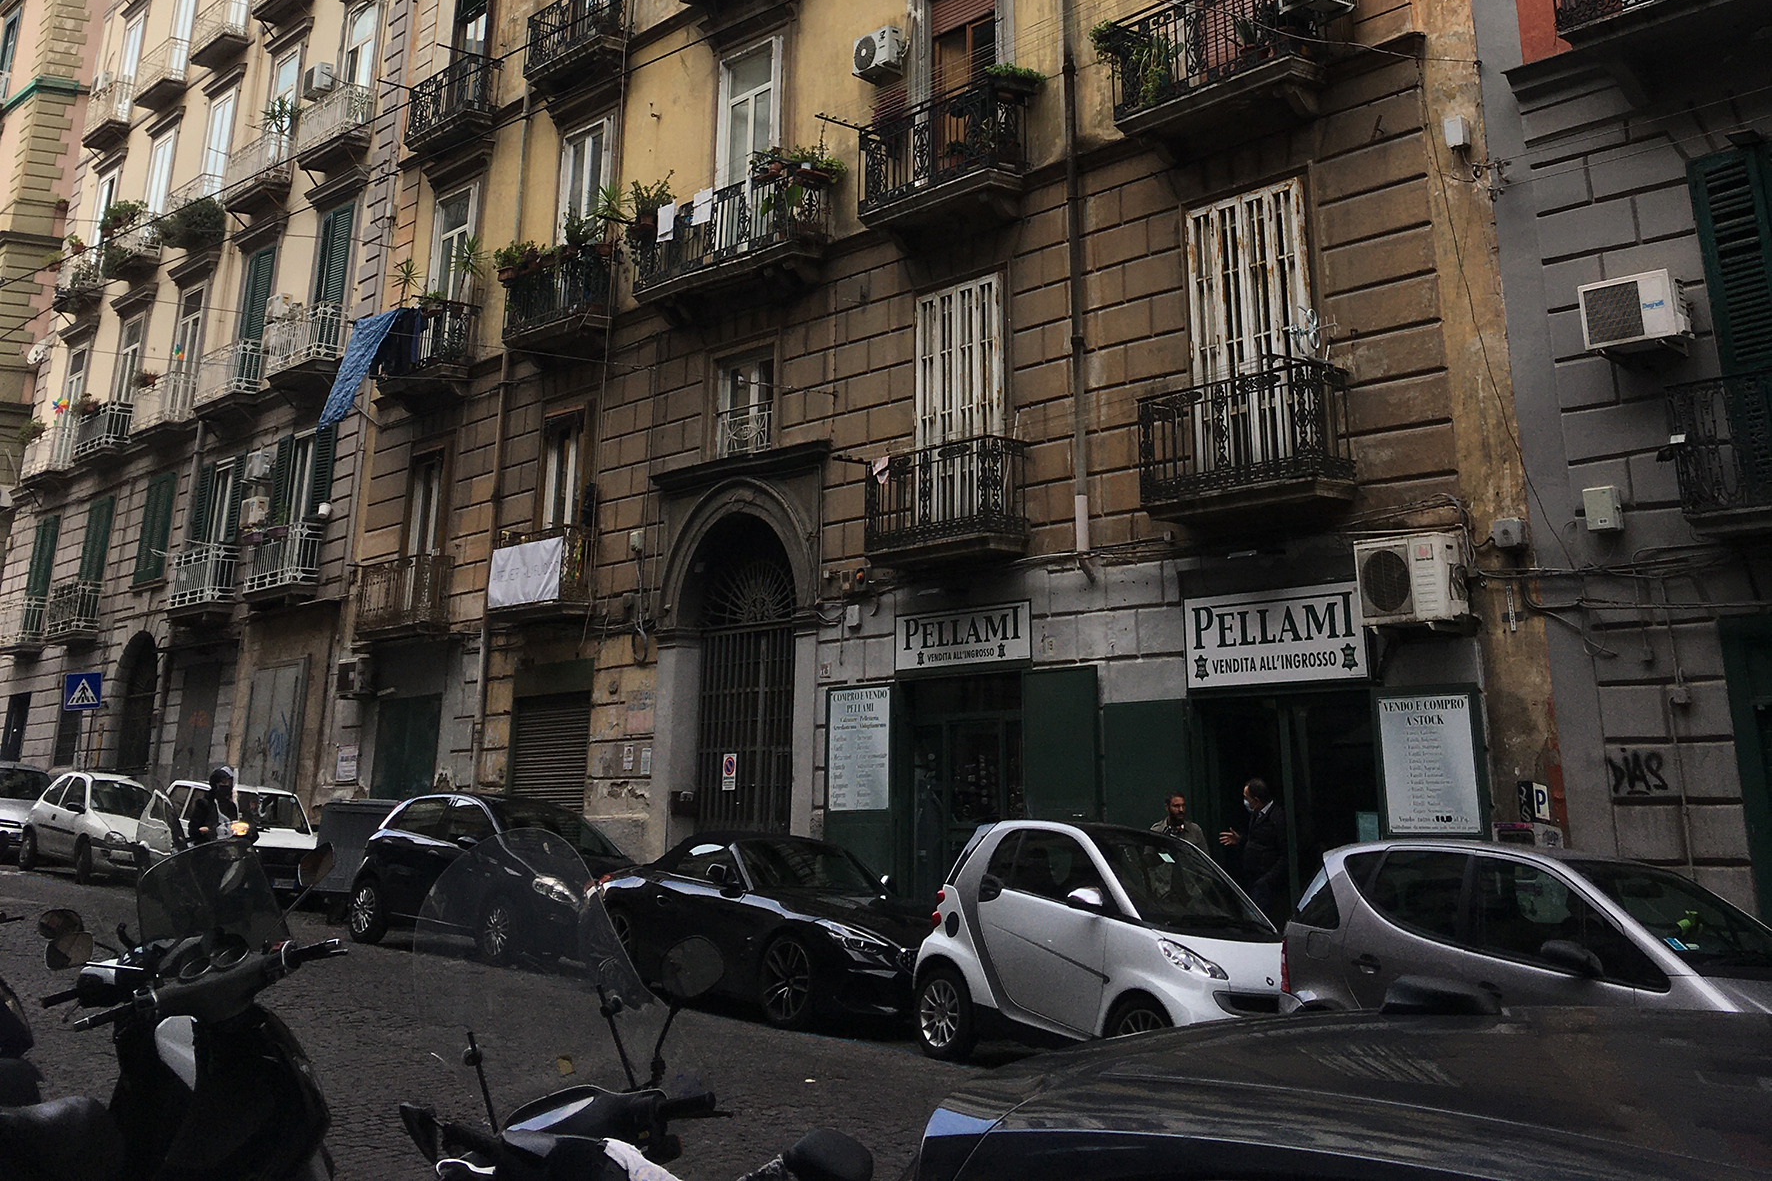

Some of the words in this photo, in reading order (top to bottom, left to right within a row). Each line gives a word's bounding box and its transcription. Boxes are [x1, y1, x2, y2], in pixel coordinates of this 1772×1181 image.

[903, 605, 1021, 651] PELLAMI
[1191, 591, 1356, 650] PELLAMI
[927, 652, 952, 663] VENDITA
[953, 647, 995, 660] ALL'INGROSSO
[1212, 656, 1257, 674] VENDITA
[1259, 650, 1337, 671] ALL'INGROSSO
[832, 691, 860, 703] COMPRO
[864, 689, 888, 700] VENDO
[846, 703, 875, 714] PELLAMI
[1383, 702, 1414, 712] VENDO
[1416, 701, 1422, 711] E
[1424, 698, 1465, 710] COMPRO
[1406, 715, 1412, 726] A
[1413, 714, 1445, 726] STOCK
[1534, 789, 1547, 814] P
